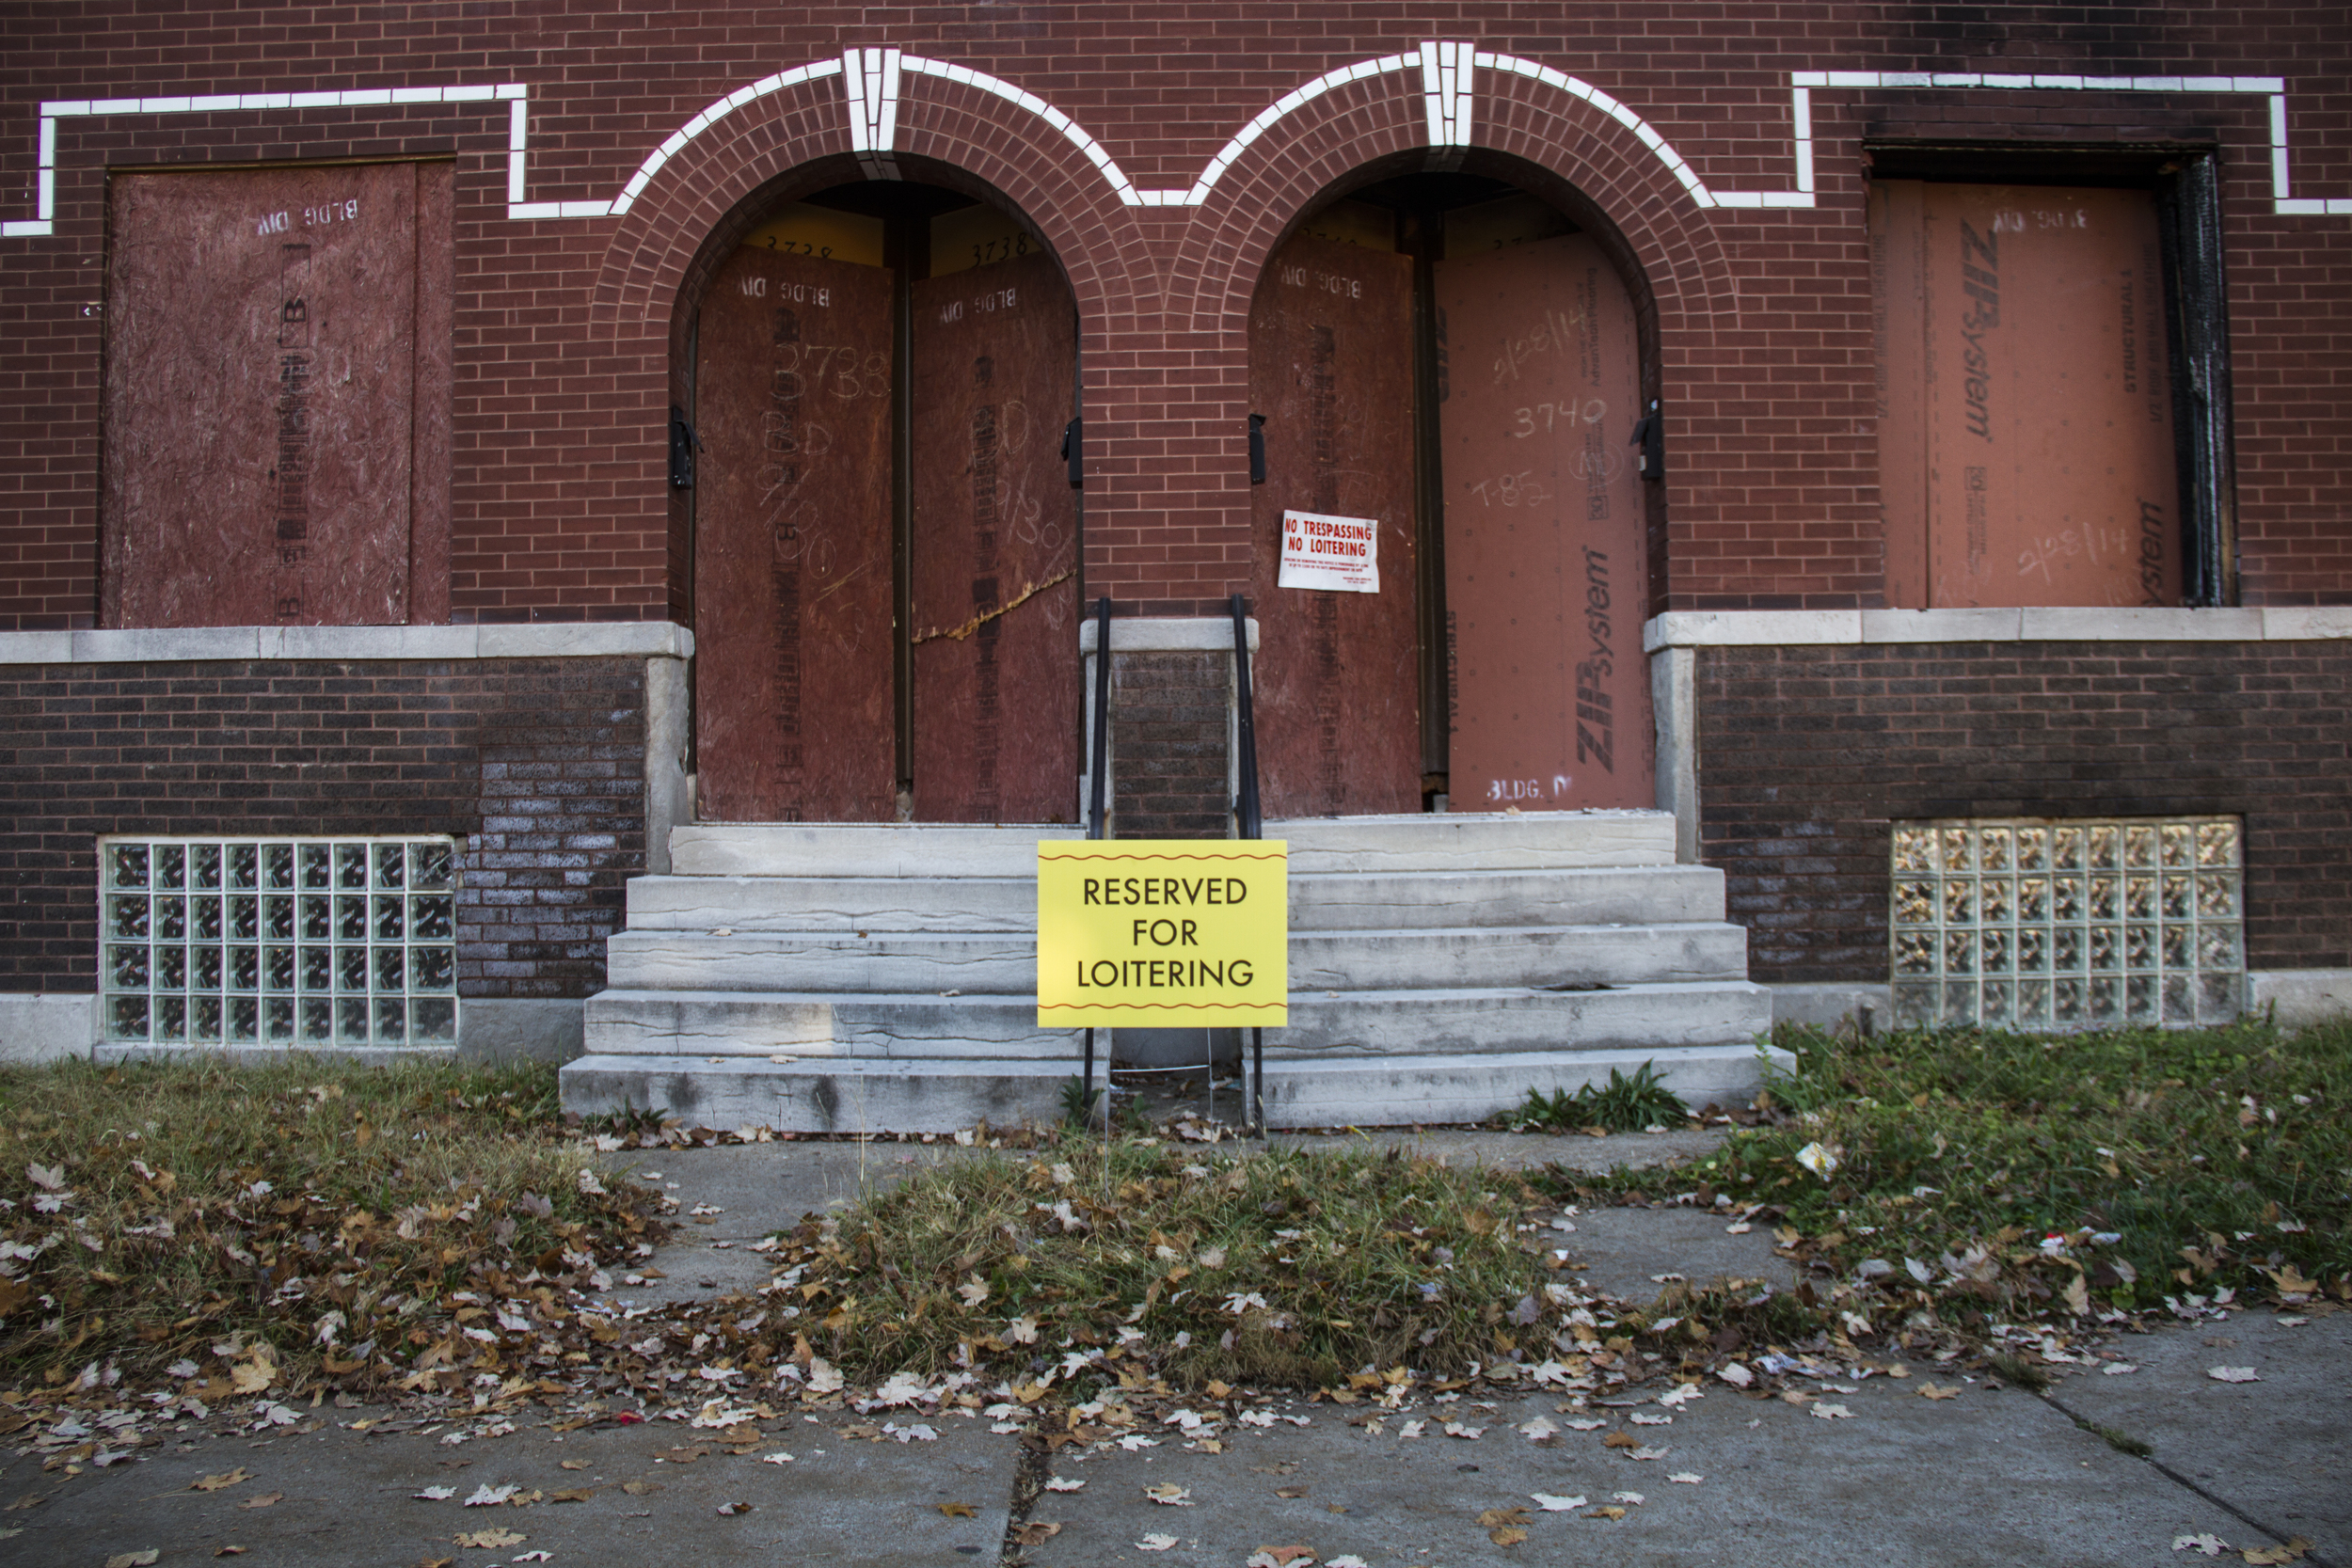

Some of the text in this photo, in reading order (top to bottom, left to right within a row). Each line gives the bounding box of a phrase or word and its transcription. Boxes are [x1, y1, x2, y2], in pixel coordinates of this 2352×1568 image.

[972, 231, 1028, 268] 3738
[1960, 216, 2001, 328] ZIP
[2121, 280, 2137, 393] STRUCTURAL
[1513, 396, 1608, 439] 3740
[1284, 517, 1373, 541] NO TRESPASSING
[1288, 536, 1366, 557] NO LOITERING
[1445, 610, 1459, 719] STRUCTURAL
[1575, 549, 1613, 775] ZIP system
[1084, 878, 1248, 906] RESERVED
[1133, 918, 1199, 946] FOR
[1077, 959, 1254, 988] LOITERING
